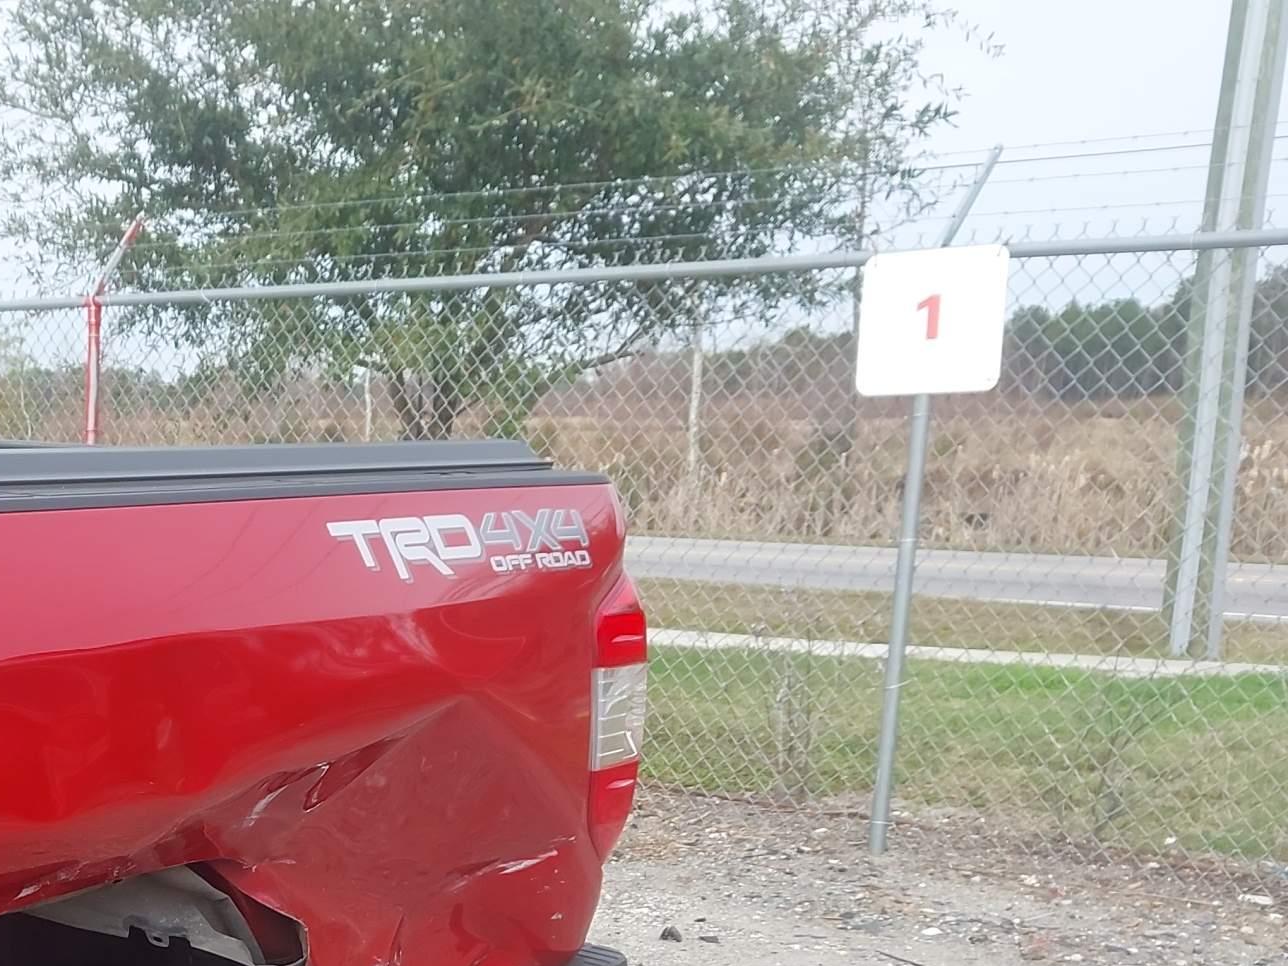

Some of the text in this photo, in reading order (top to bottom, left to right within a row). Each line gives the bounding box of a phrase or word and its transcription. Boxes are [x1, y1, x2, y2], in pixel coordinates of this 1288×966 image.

[916, 294, 941, 340] 1
[326, 514, 485, 583] TRD
[490, 550, 593, 573] OFF ROAD
